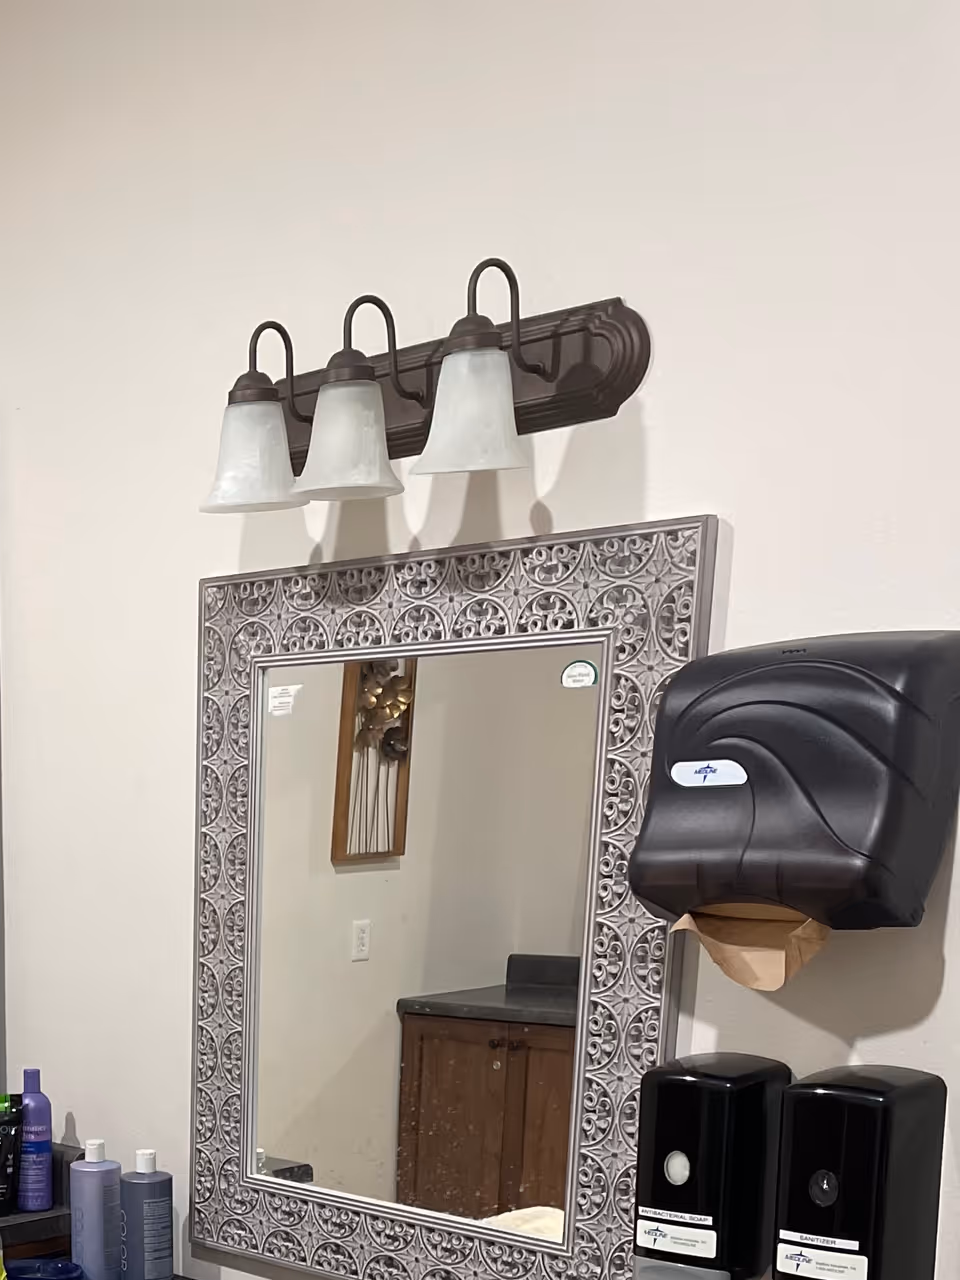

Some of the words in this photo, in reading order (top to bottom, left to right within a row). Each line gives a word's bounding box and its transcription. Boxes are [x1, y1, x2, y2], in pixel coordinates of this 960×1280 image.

[640, 1207, 688, 1221] ANTIBACTERIAL
[688, 1214, 710, 1223] SOAP
[799, 1234, 837, 1246] SANITIZER
